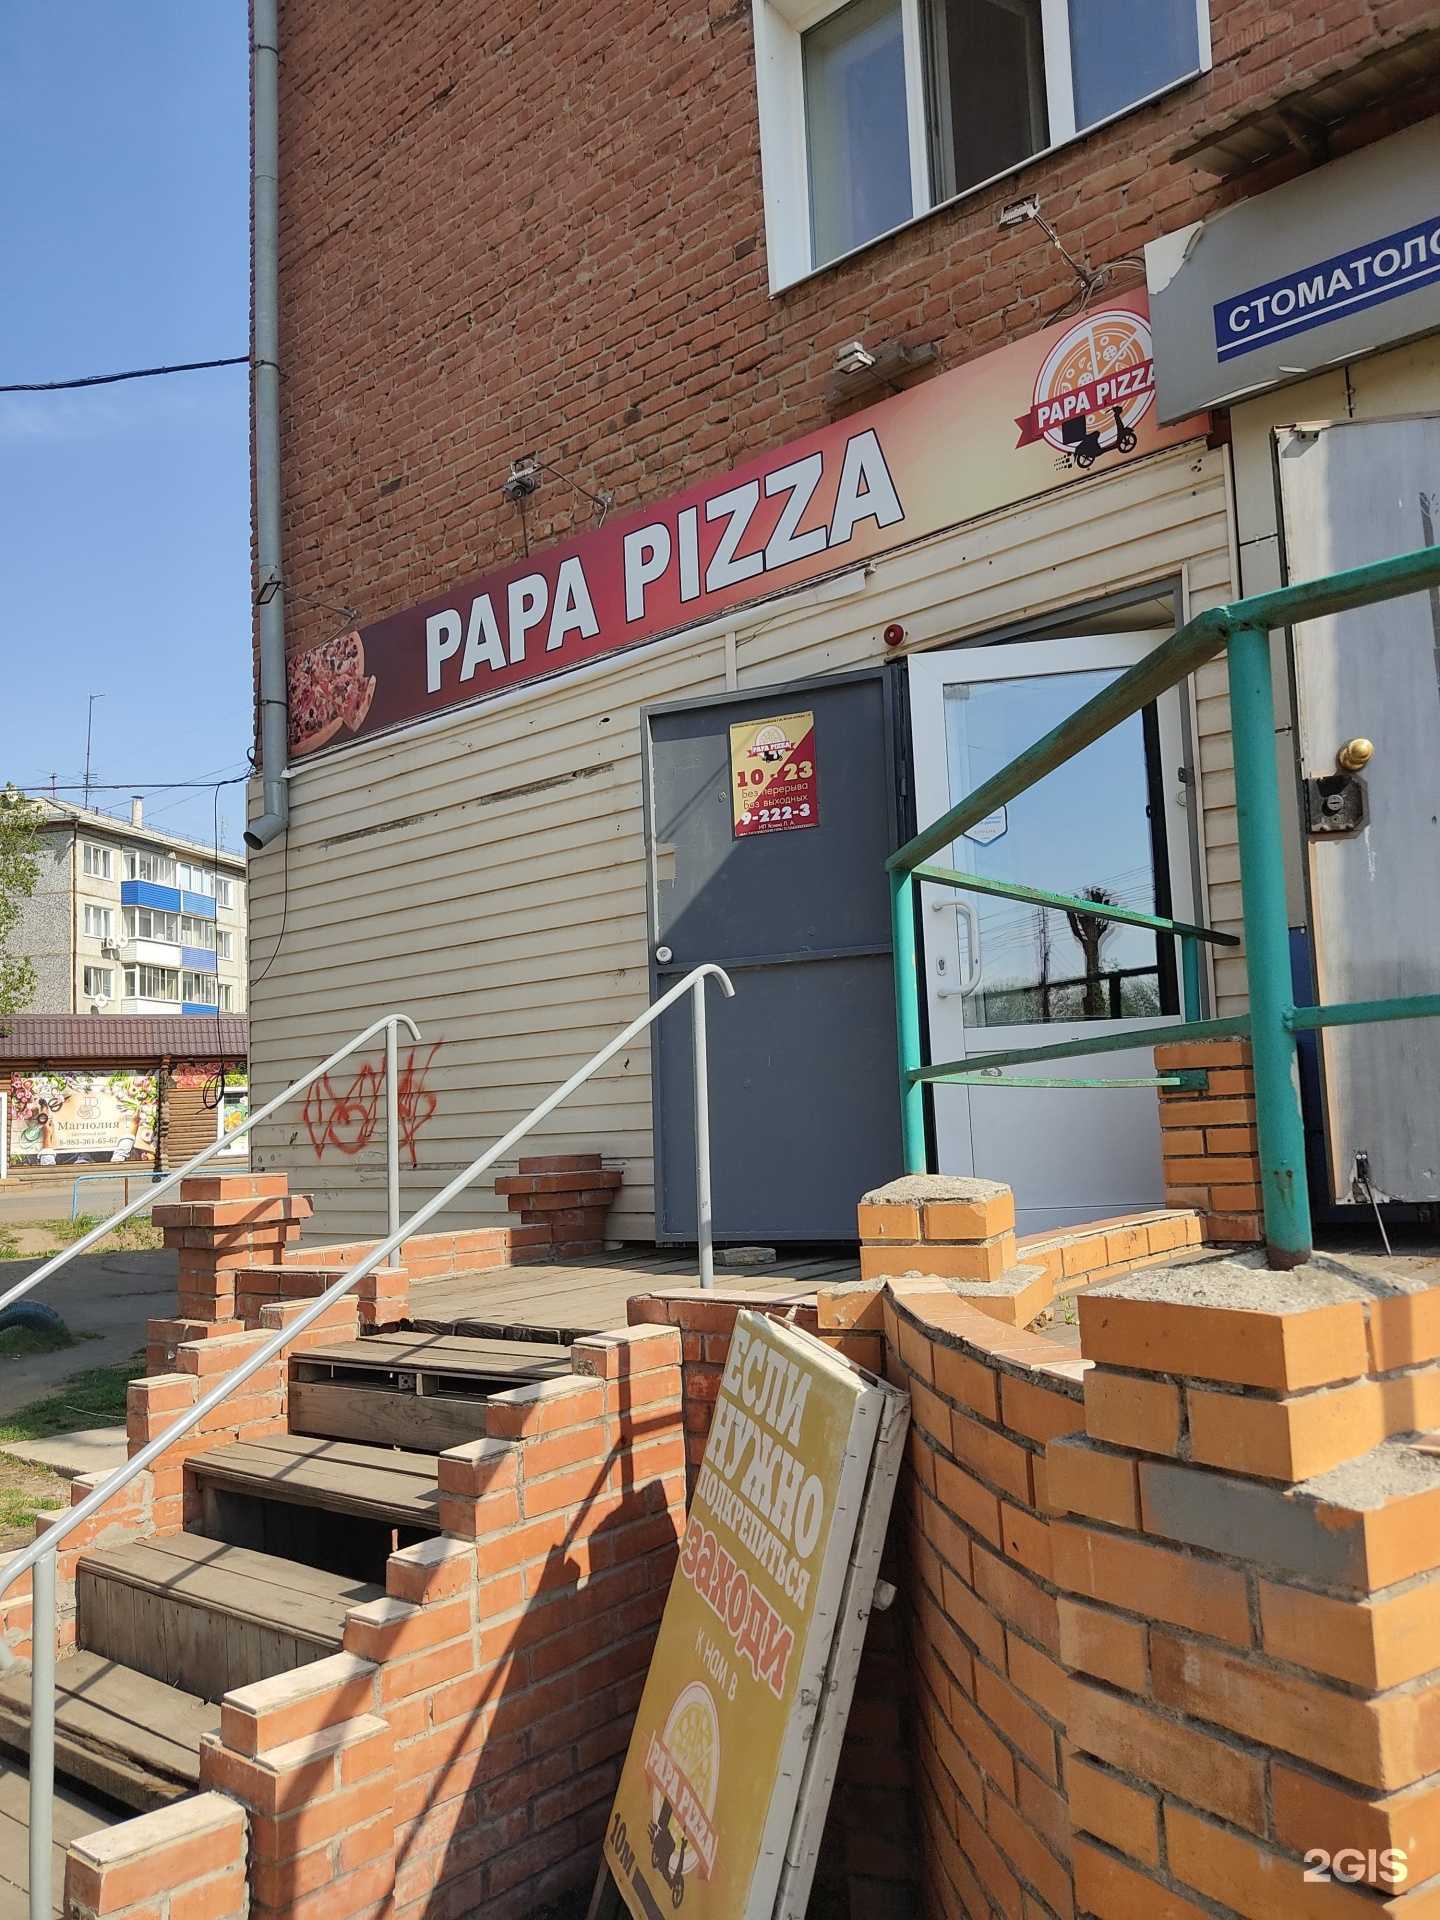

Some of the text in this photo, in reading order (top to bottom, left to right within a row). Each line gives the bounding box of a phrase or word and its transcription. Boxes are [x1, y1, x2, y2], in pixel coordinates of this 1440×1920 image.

[1037, 392, 1091, 428] PAPA
[425, 428, 906, 694] PAPA PIZZA
[737, 768, 764, 788] 10
[783, 760, 813, 780] 23
[741, 803, 811, 825] 9-222-3
[763, 794, 808, 808] выходных
[58, 1121, 120, 1131] Магнолия
[722, 1327, 813, 1447] ЕСЛИ
[705, 1397, 824, 1558] НУЖНО
[696, 1463, 811, 1612] ПОДКРЕПИТЬСЯ
